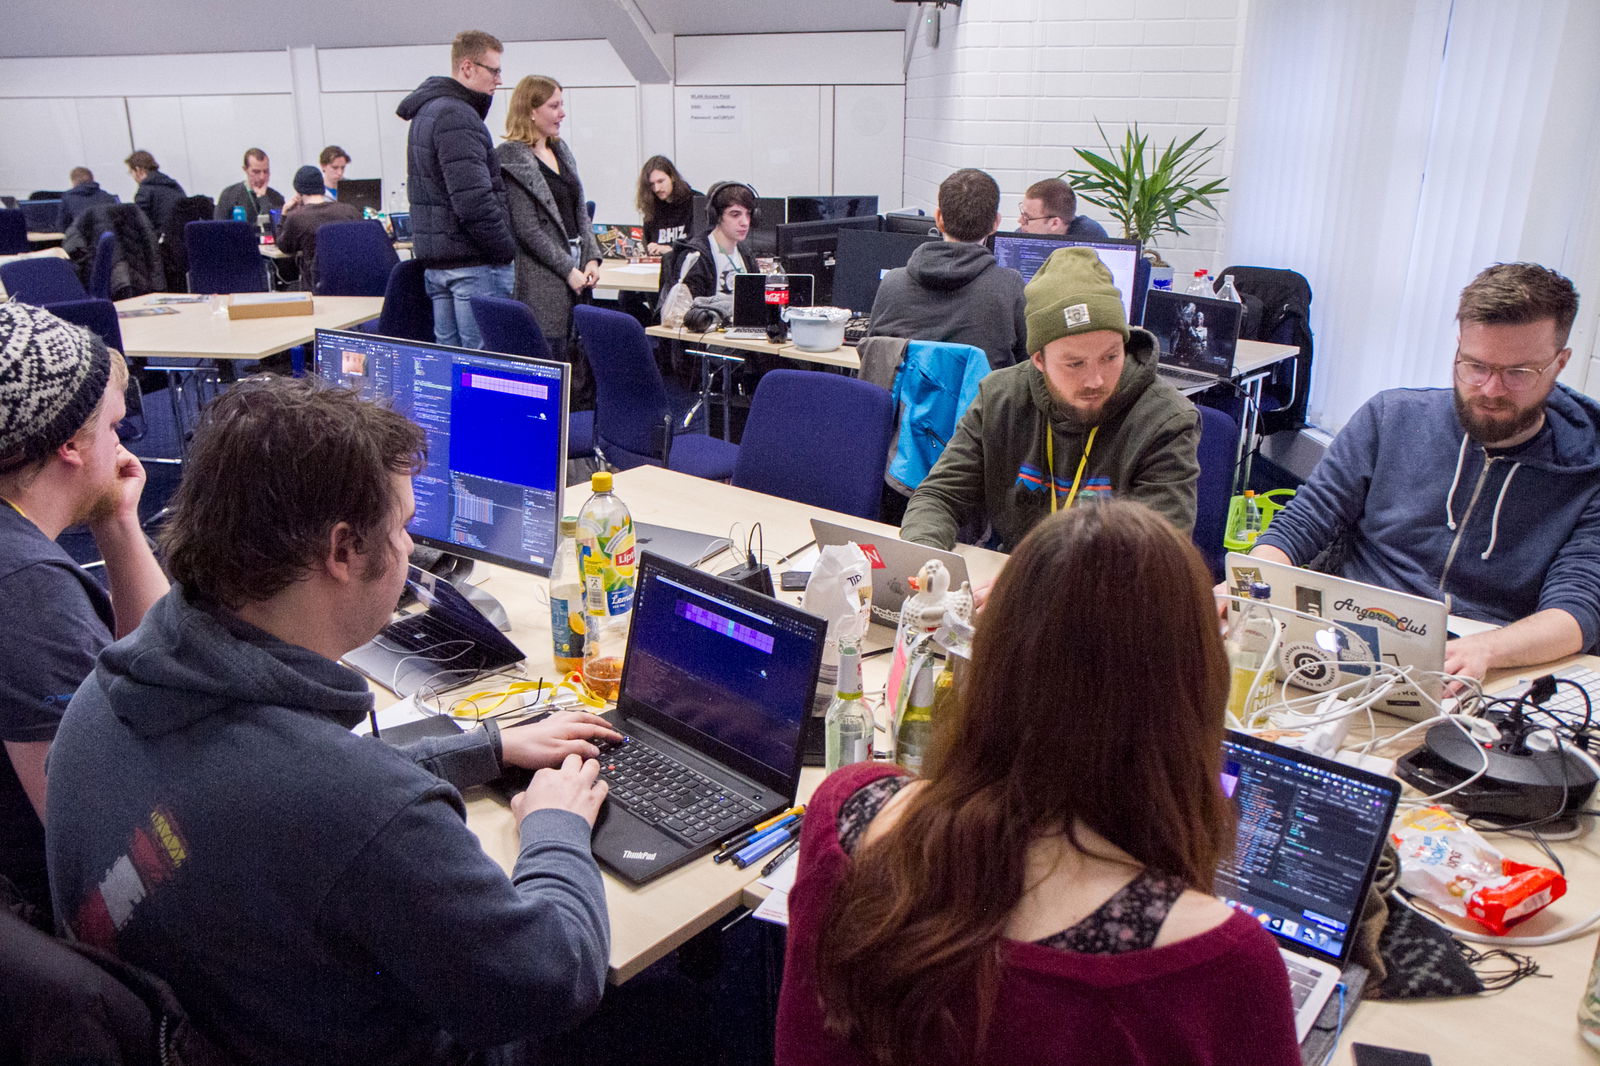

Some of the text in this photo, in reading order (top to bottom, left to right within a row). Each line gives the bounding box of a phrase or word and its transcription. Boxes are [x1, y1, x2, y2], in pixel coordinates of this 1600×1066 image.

[1333, 598, 1392, 624] Angora
[1396, 616, 1427, 636] Club
[622, 850, 657, 861] ThinkPad
